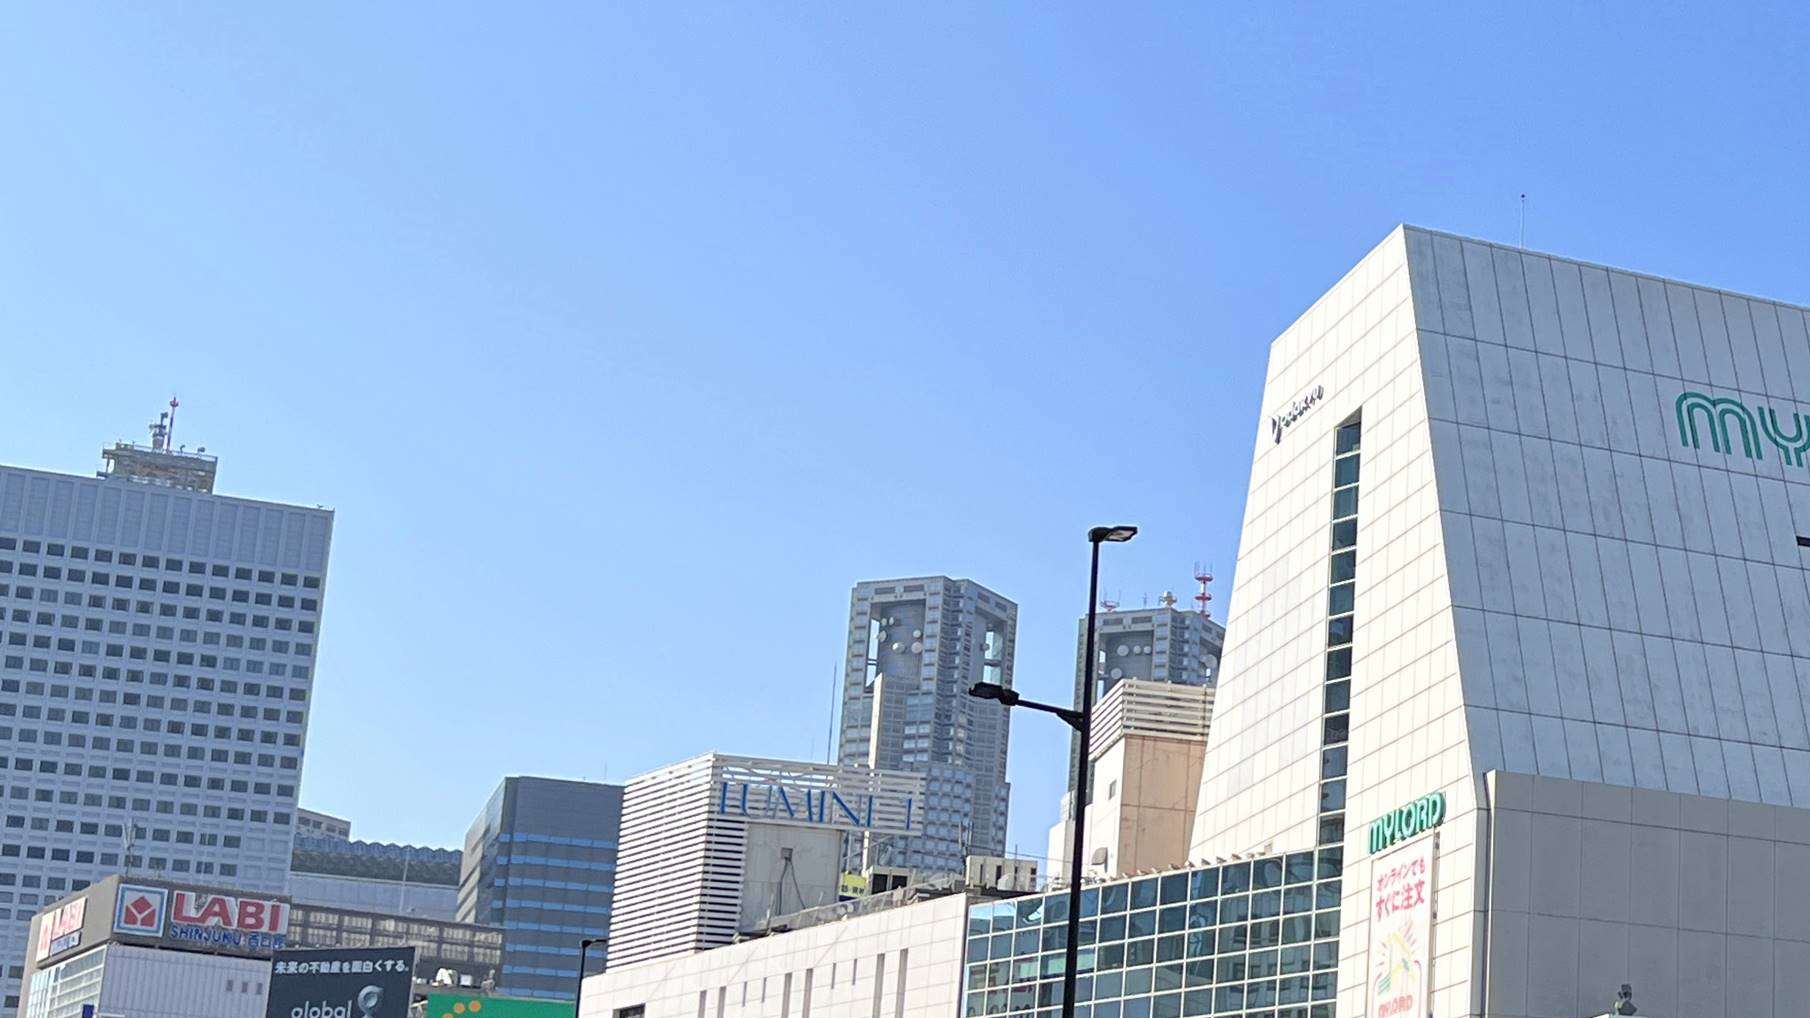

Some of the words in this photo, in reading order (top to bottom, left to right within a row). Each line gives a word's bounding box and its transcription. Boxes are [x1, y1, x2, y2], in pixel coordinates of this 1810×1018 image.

[1367, 791, 1446, 855] MYLORD
[171, 890, 284, 933] LABI
[169, 925, 242, 946] SHINJUKU
